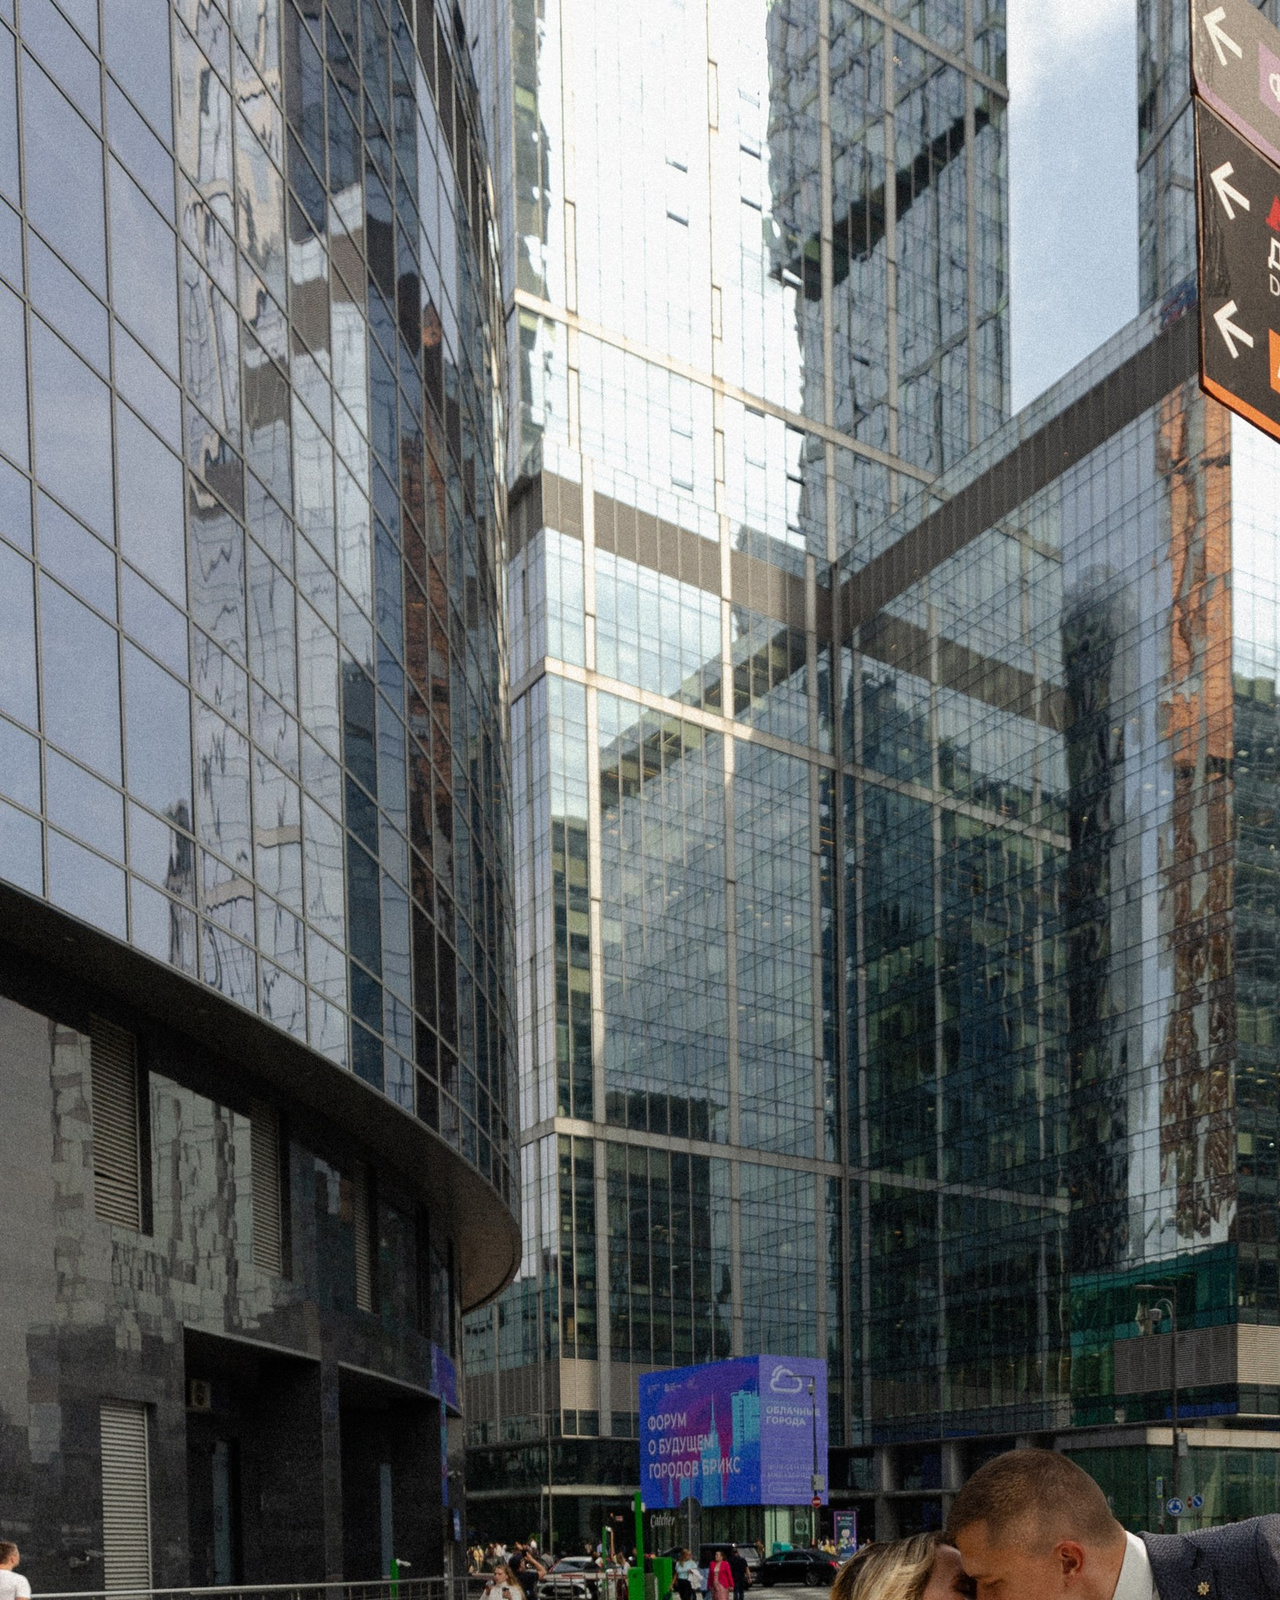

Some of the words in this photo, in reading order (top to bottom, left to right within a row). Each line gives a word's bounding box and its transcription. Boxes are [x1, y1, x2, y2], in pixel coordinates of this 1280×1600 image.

[765, 1405, 820, 1417] ОБЛАЧНЫЕ
[647, 1412, 687, 1431] ФОРУМ
[766, 1416, 806, 1428] ГОРОДА
[648, 1439, 656, 1455] О
[658, 1433, 714, 1456] БУДУЩЕМ
[649, 1460, 699, 1479] ГОРОДОВ
[701, 1456, 741, 1476] БРИКС
